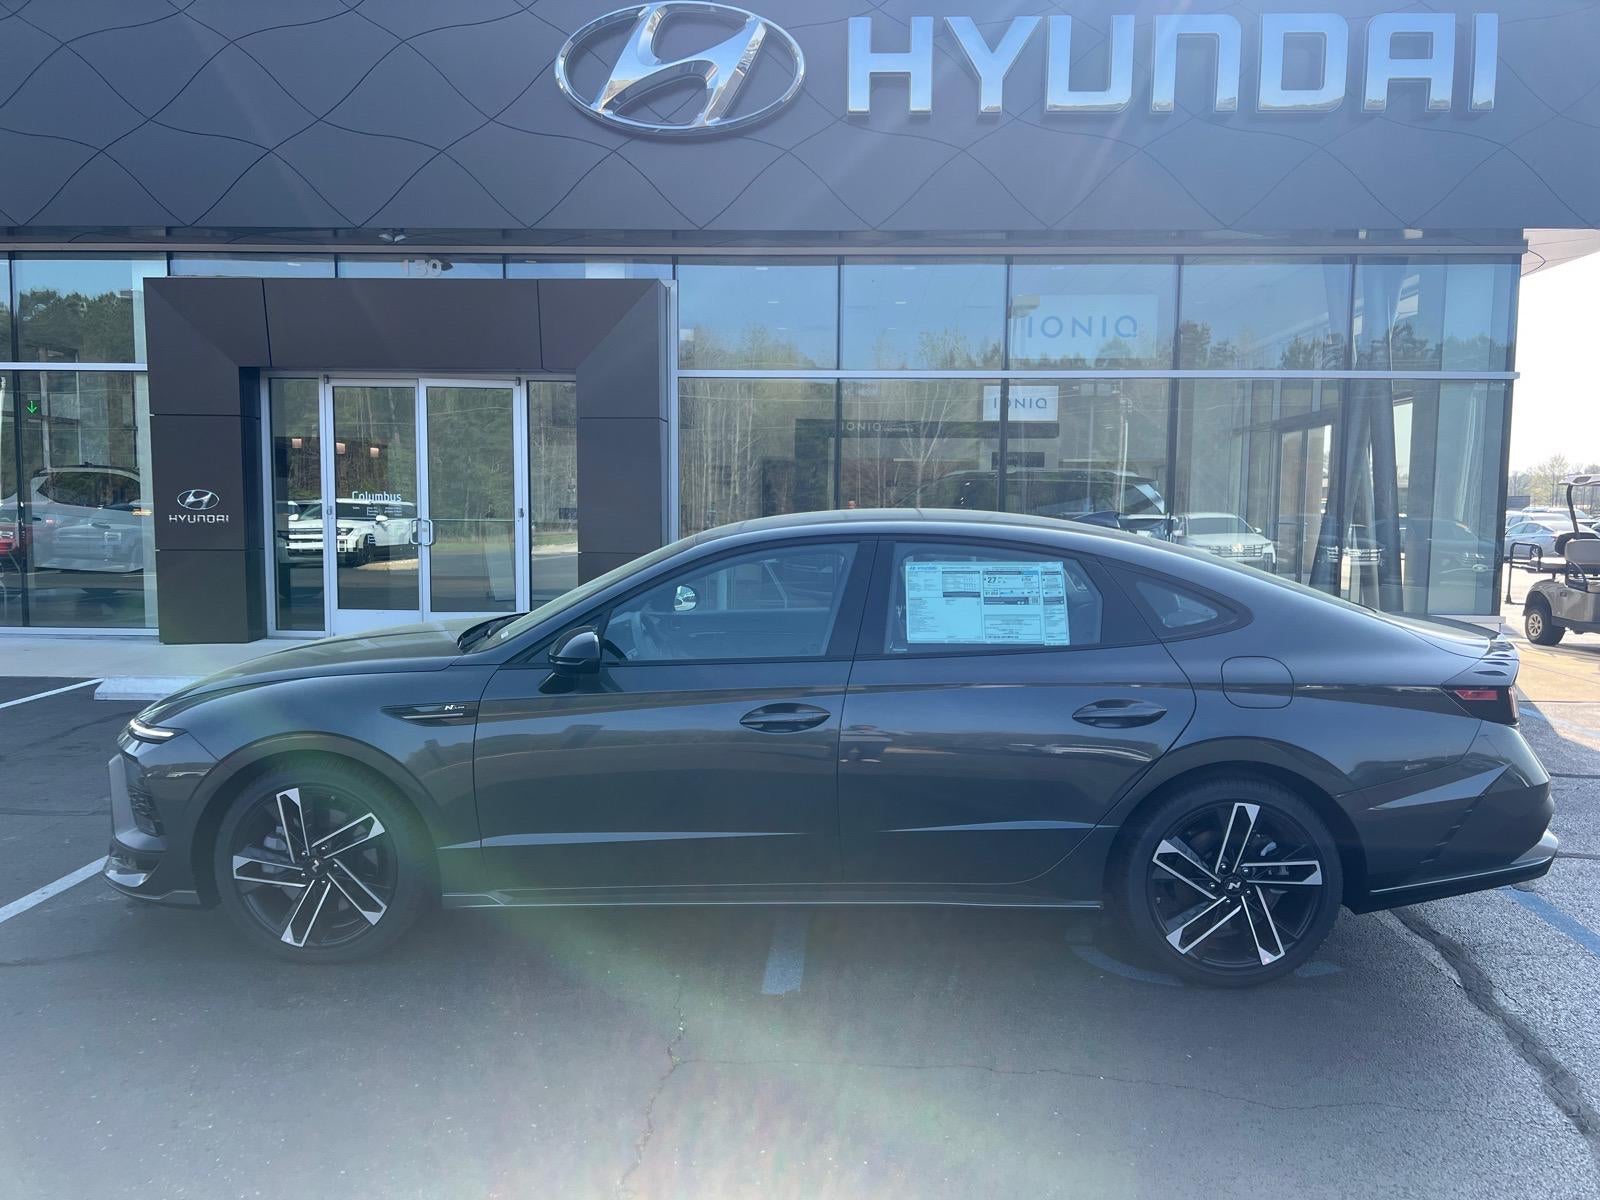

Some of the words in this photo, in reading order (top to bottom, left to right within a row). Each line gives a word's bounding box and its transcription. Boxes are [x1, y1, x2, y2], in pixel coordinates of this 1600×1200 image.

[845, 12, 1499, 114] HYUNDAI
[1027, 315, 1138, 338] IONIQ
[993, 397, 1048, 409] INIQ
[351, 490, 402, 501] Columbus
[168, 514, 230, 524] HYUNDAI
[987, 576, 997, 584] 27
